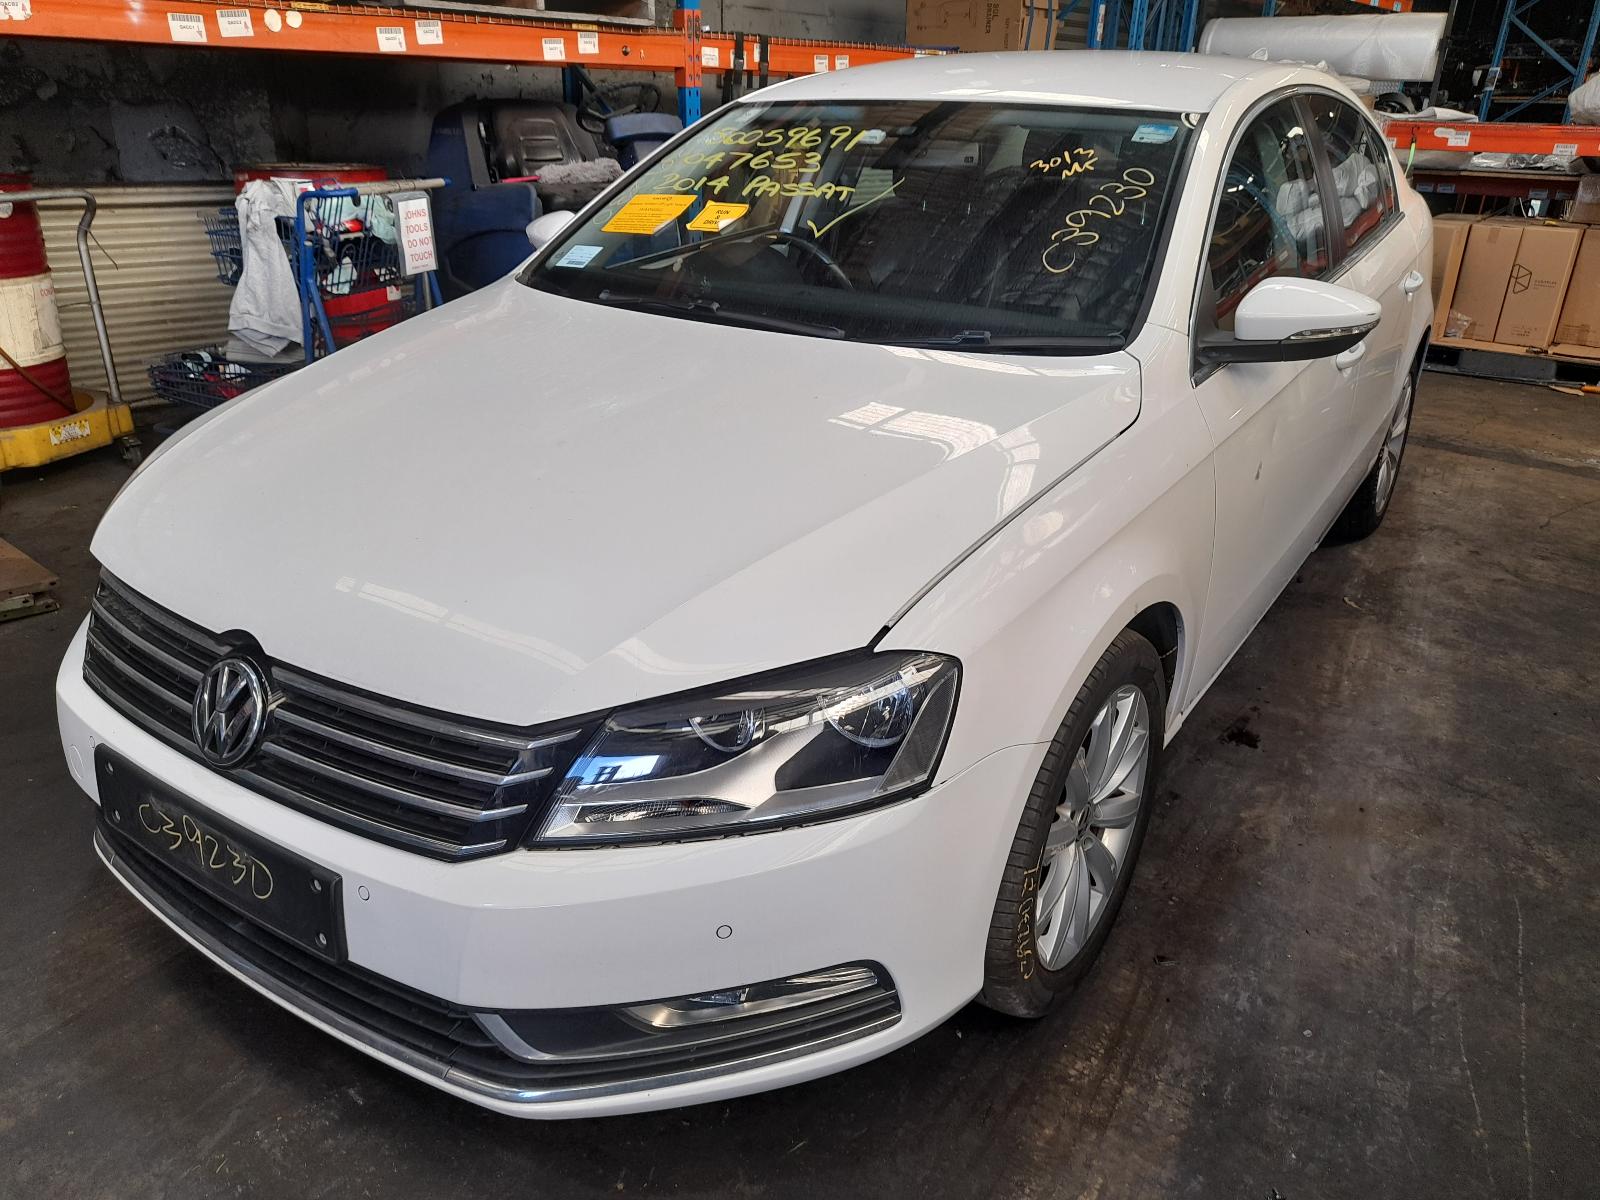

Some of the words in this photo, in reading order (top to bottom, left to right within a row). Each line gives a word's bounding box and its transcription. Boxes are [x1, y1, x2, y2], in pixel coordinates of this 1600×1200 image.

[653, 174, 731, 195] 2014
[742, 176, 856, 201] PASSAT
[404, 208, 427, 220] JOHNS
[406, 222, 429, 235] TOOLS
[407, 238, 418, 249] DO
[410, 250, 433, 263] TOUCH
